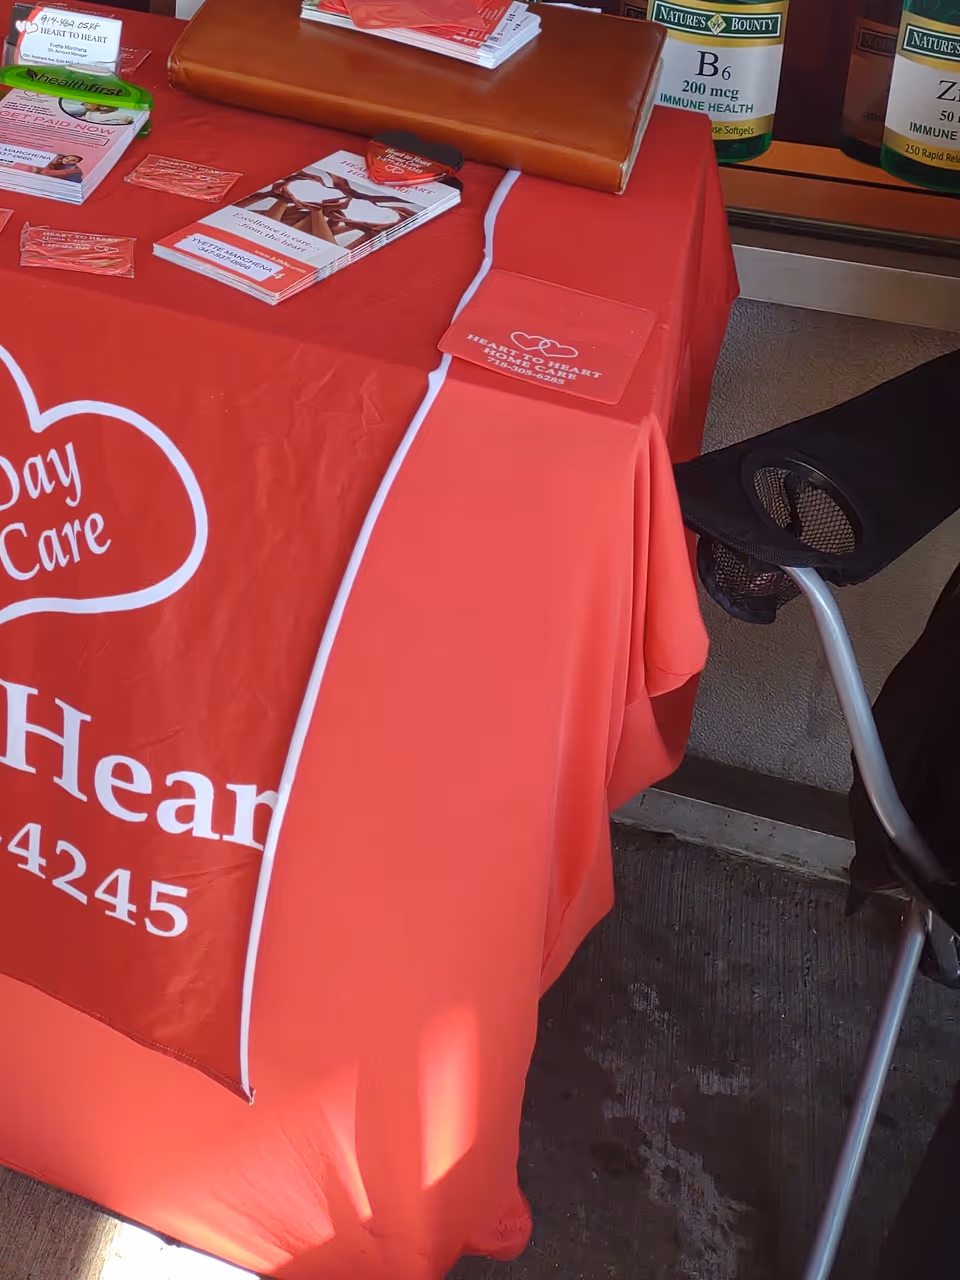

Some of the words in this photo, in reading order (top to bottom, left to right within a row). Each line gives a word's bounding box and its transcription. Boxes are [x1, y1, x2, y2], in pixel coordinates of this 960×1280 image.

[658, 6, 707, 28] NATURE'S
[730, 17, 775, 32] BOUNTY
[40, 27, 68, 38] HEART
[69, 31, 80, 39] TO
[80, 33, 108, 44] HEART
[696, 50, 732, 81] B6
[37, 72, 125, 96] healthfirst
[681, 79, 706, 95] 200
[710, 87, 740, 101] mcg
[659, 92, 706, 111] IMMUNE
[707, 100, 755, 114] HEALTH
[33, 116, 71, 128] PAID
[74, 122, 116, 136] NOW
[939, 110, 955, 124] 50
[724, 125, 755, 137] Softgels
[909, 121, 958, 141] IMMUNE
[7, 147, 52, 161] MARCHENA
[384, 147, 405, 158] Heart
[404, 153, 413, 161] to
[413, 156, 433, 167] Heart
[904, 143, 920, 156] 250
[921, 147, 944, 163] Rapid
[232, 211, 280, 235] Excellence
[280, 231, 290, 240] in
[263, 231, 280, 243] the
[280, 238, 307, 253] heart
[191, 236, 225, 253] YVETTE
[225, 248, 274, 273] MARCHENA
[465, 333, 520, 356] HEART
[521, 352, 545, 365] TO
[547, 360, 604, 379] HEART
[482, 347, 531, 371] HOME
[534, 364, 578, 381] CARE
[486, 356, 566, 386] 718-305-6285
